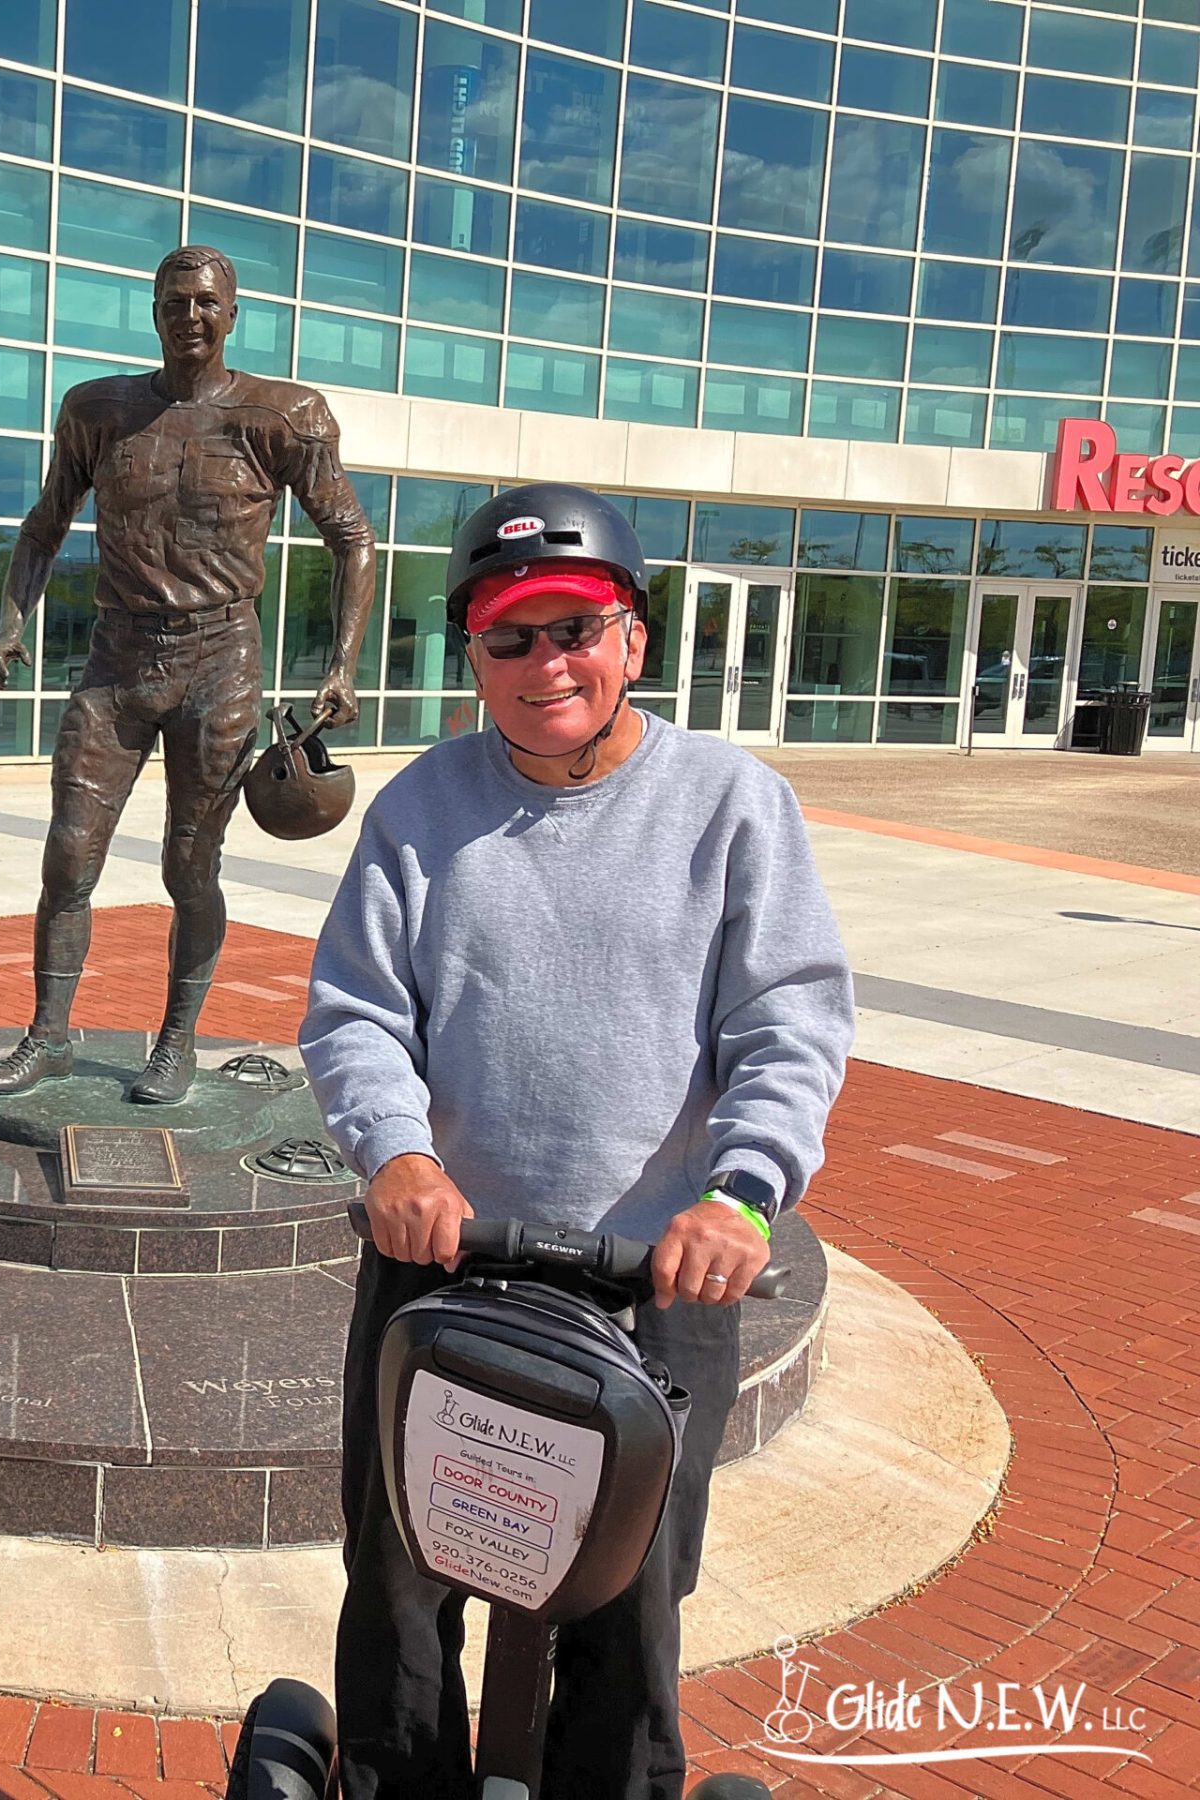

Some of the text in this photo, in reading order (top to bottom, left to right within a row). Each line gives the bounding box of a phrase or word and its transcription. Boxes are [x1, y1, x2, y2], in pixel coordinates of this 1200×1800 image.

[451, 74, 469, 133] LIGHT
[504, 521, 537, 535] BELL
[536, 1241, 584, 1256] SEGWAY
[182, 1375, 336, 1396] Weyers
[459, 1412, 576, 1466] Glide N.E.W. LLC
[460, 1450, 492, 1468] Guided
[496, 1462, 522, 1479] Tours
[444, 1466, 547, 1512] DOOR COUNTY
[452, 1498, 530, 1534] GREEN BAY
[445, 1521, 530, 1561] FOX VALLEY
[432, 1541, 537, 1590] 920-376-0256
[434, 1556, 533, 1600] GlideNew.com
